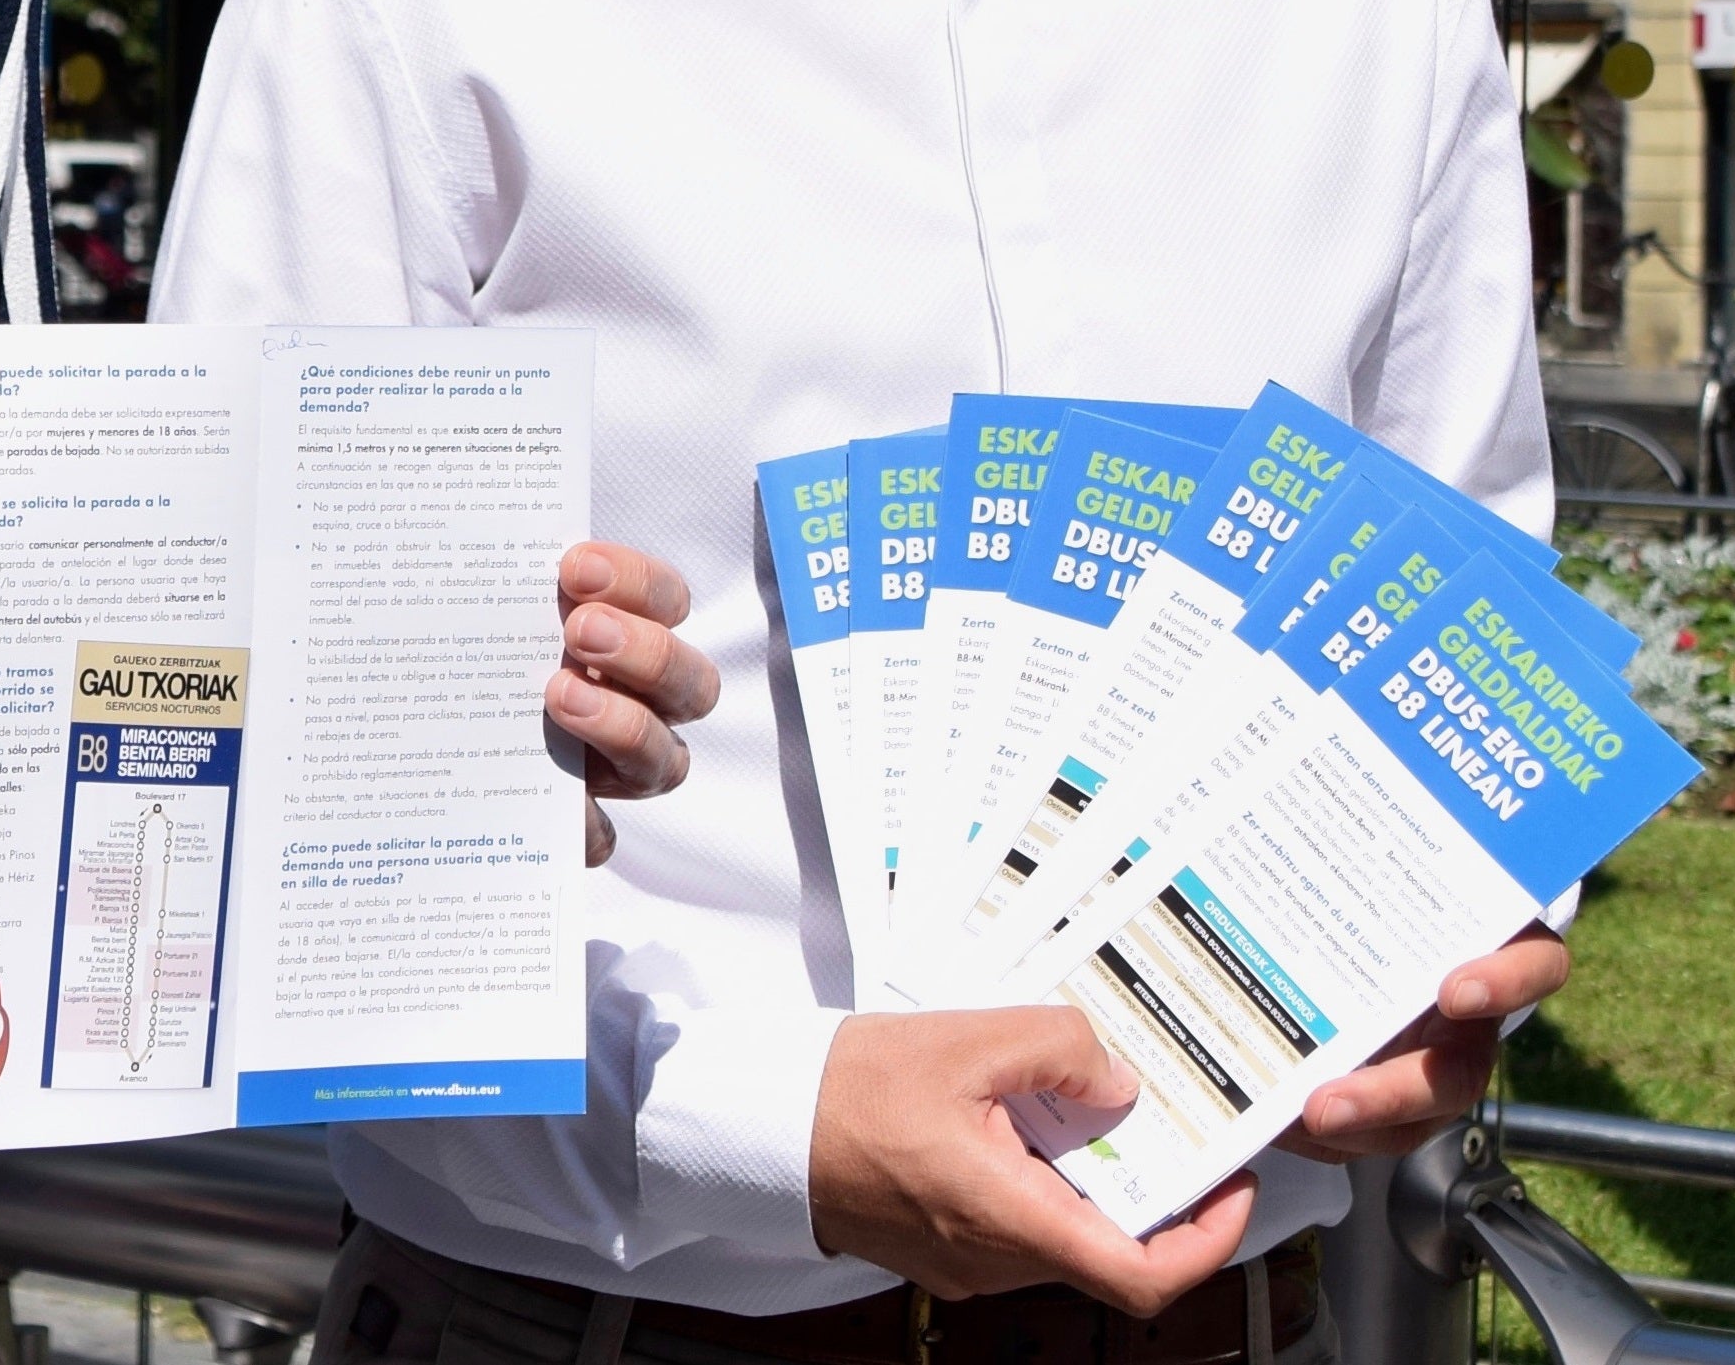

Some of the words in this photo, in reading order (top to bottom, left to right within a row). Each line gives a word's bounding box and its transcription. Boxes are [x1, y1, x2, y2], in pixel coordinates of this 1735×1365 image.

[0, 365, 43, 381] puede
[48, 365, 102, 378] solicitar
[107, 365, 120, 377] la
[125, 365, 176, 381] parada
[181, 369, 189, 377] a
[194, 365, 206, 377] la
[301, 365, 335, 381] ¿Qué
[339, 365, 413, 378] condiciones
[418, 365, 449, 378] debe
[454, 366, 491, 378] reunir
[495, 370, 510, 378] un
[515, 368, 550, 381] punto
[300, 387, 331, 398] para
[336, 383, 375, 398] poder
[379, 383, 428, 395] realizar
[433, 383, 444, 395] la
[449, 383, 495, 398] parada
[499, 387, 507, 395] a
[511, 383, 522, 395] la
[299, 400, 370, 412] demanda?
[2, 501, 16, 509] se
[22, 496, 68, 509] solicita
[73, 495, 86, 508] la
[91, 495, 140, 511] parada
[145, 499, 154, 507] a
[159, 495, 170, 507] la
[967, 531, 1011, 561] B8
[1206, 518, 1254, 560] B8
[1052, 554, 1099, 592] B8
[881, 571, 925, 600] B8
[113, 655, 157, 666] GAUEKO
[159, 657, 221, 668] ZERBITZUAK
[6, 667, 53, 678] tramos
[40, 686, 54, 695] se
[80, 668, 130, 698] GAU
[141, 671, 238, 702] TXORIAK
[1459, 598, 1630, 766] ESKARIPEKO
[105, 701, 158, 713] SERVICIOS
[161, 704, 221, 715] NOCTURNOS
[1439, 625, 1603, 794] GELDIALDIAK
[1407, 647, 1544, 791] DBUS-EKO
[119, 728, 217, 746] MIRACONCHA
[77, 734, 108, 773] B8
[119, 745, 166, 761] BENTA
[169, 747, 210, 762] BERRI
[1380, 673, 1426, 719] B8
[1419, 714, 1524, 821] LINEAN
[117, 761, 197, 779] SEMINARIO
[1327, 733, 1361, 771] Zertan
[1361, 771, 1390, 801] datza
[1389, 802, 1442, 854] proiektua?
[9, 849, 35, 860] Pinos
[282, 842, 327, 857] ¿Cómo
[332, 839, 372, 856] puede
[377, 838, 426, 851] solicitar
[430, 836, 442, 848] la
[446, 835, 494, 851] parada
[498, 838, 506, 846] a
[511, 834, 523, 845] la
[282, 857, 344, 872] demanda
[349, 860, 373, 869] una
[377, 857, 429, 871] persona
[434, 853, 482, 865] usuaria
[487, 855, 511, 866] que
[516, 851, 549, 865] viaja
[8, 872, 35, 882] Hériz
[281, 881, 296, 889] en
[302, 876, 328, 888] silla
[332, 875, 348, 887] de
[353, 873, 403, 886] ruedas?
[1242, 810, 1261, 830] Zer
[1260, 832, 1299, 874] zerbitzu
[1300, 875, 1330, 907] egiten
[1330, 909, 1344, 922] du
[1344, 921, 1360, 937] B8
[1358, 936, 1390, 967] Lineak?
[1204, 900, 1269, 971] ORDUTEGIAK
[1270, 973, 1317, 1022] HORARIOS
[314, 1089, 335, 1100] Más
[337, 1086, 394, 1099] información
[396, 1088, 408, 1096] en
[411, 1083, 501, 1096] www.dbus.eus
